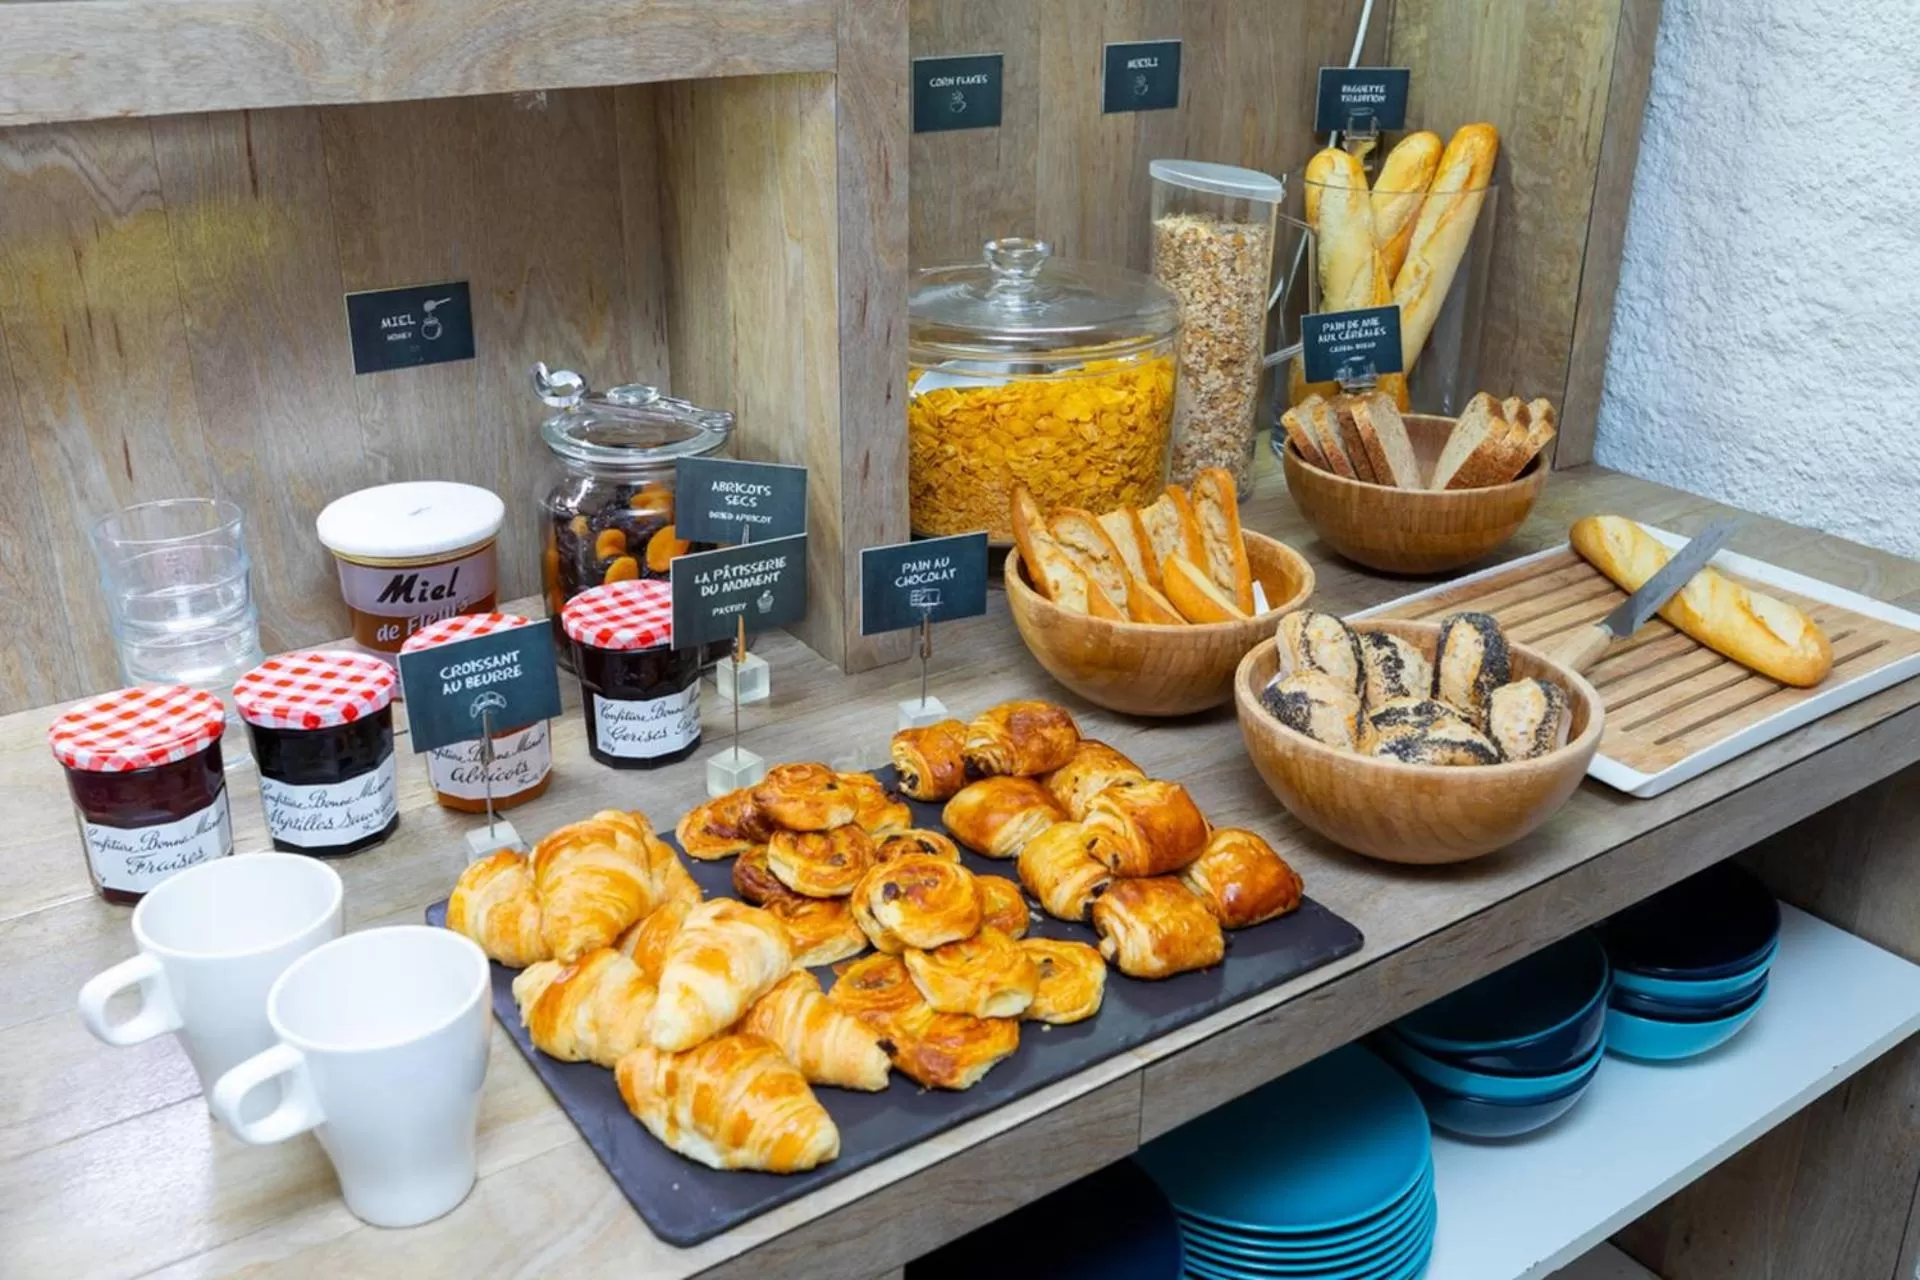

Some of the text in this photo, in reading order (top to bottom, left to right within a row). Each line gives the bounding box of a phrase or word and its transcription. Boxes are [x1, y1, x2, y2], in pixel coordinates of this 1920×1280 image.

[929, 74, 988, 88] CORN FLAKES
[380, 313, 417, 329] MIEL
[1322, 321, 1346, 333] PAIN
[1347, 319, 1360, 329] DE
[386, 332, 413, 341] HONEY
[1318, 333, 1337, 344] AUX
[711, 480, 772, 497] ABRICOTS
[725, 494, 758, 508] SECS
[708, 510, 773, 524] DRIED APRICOT
[694, 556, 787, 585] LA PÂTISSERIE
[902, 556, 951, 575] PAIN AU
[375, 566, 460, 604] Miel
[701, 570, 781, 598] DU MOMENT
[895, 567, 957, 588] CHOCOLAT
[712, 602, 747, 617] PASTRY
[375, 624, 401, 643] de
[439, 649, 521, 680] CROISSANT
[442, 664, 523, 696] AU BEURRE
